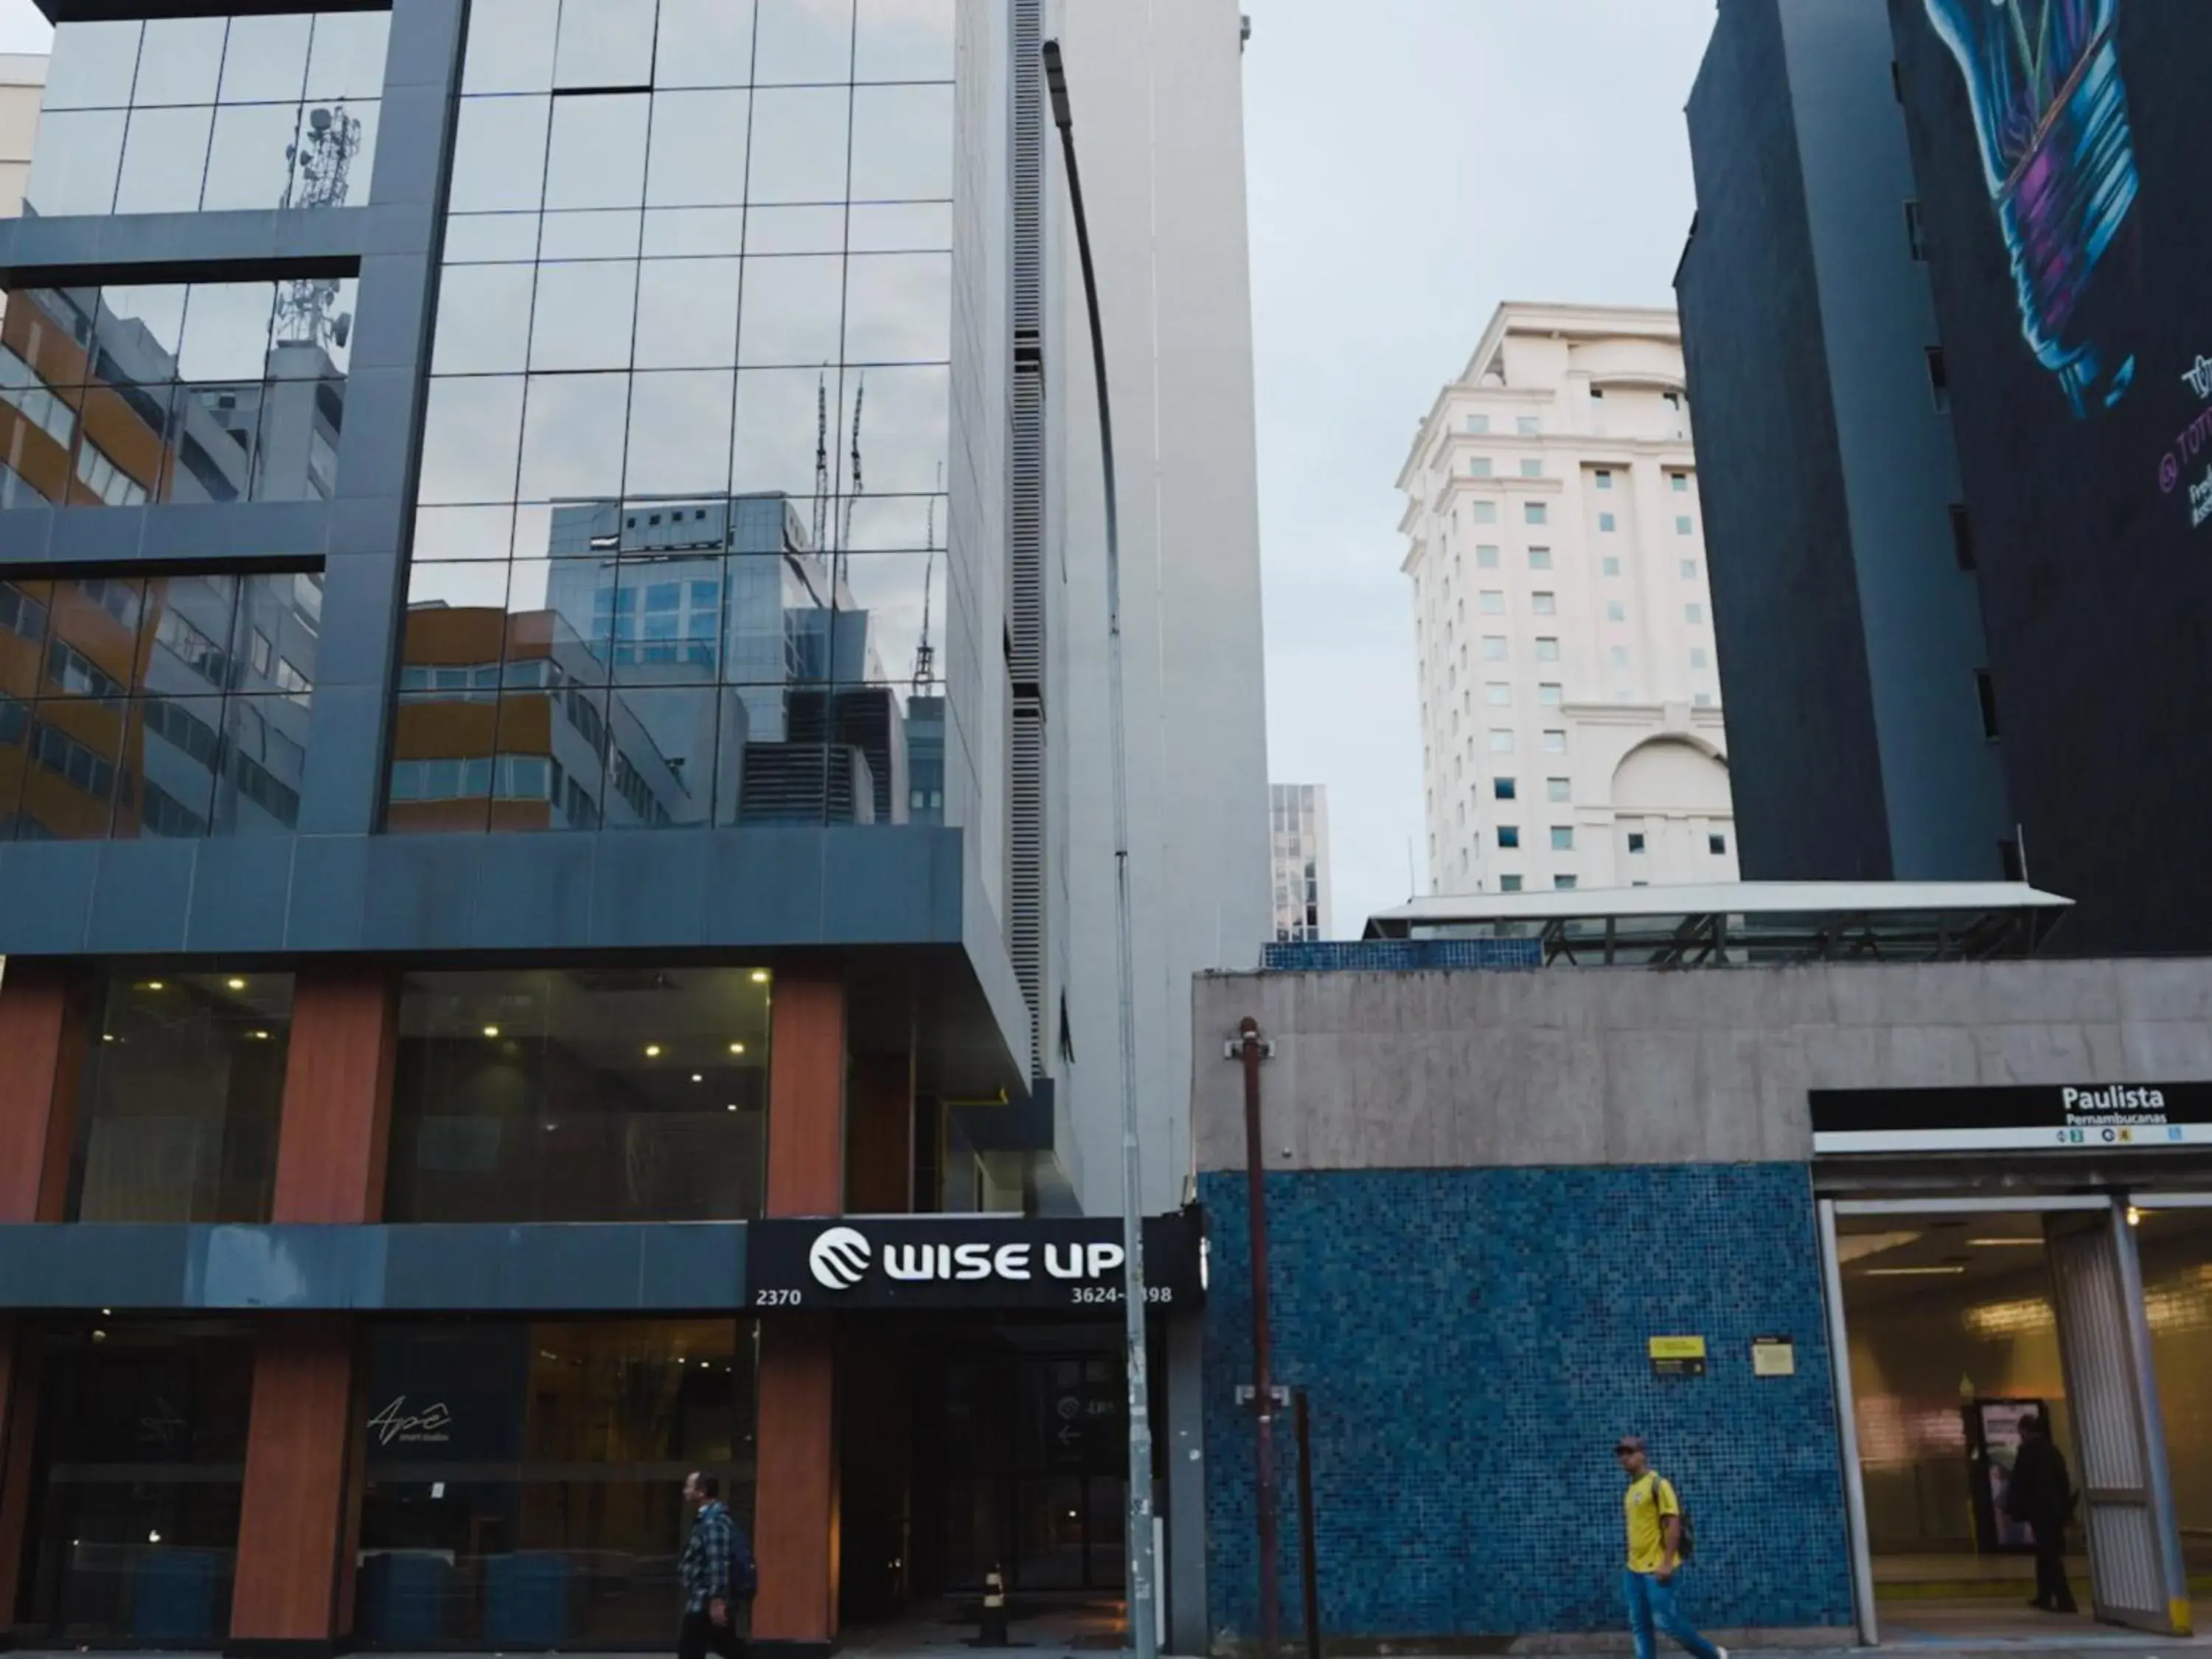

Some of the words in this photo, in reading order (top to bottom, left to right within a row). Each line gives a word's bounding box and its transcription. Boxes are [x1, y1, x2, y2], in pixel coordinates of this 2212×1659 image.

[2062, 1085, 2165, 1110] Paulista
[883, 1243, 1032, 1280] WISE
[1044, 1243, 1124, 1278] UP
[756, 1289, 801, 1306] 2370
[1071, 1287, 1172, 1303] 3624-98
